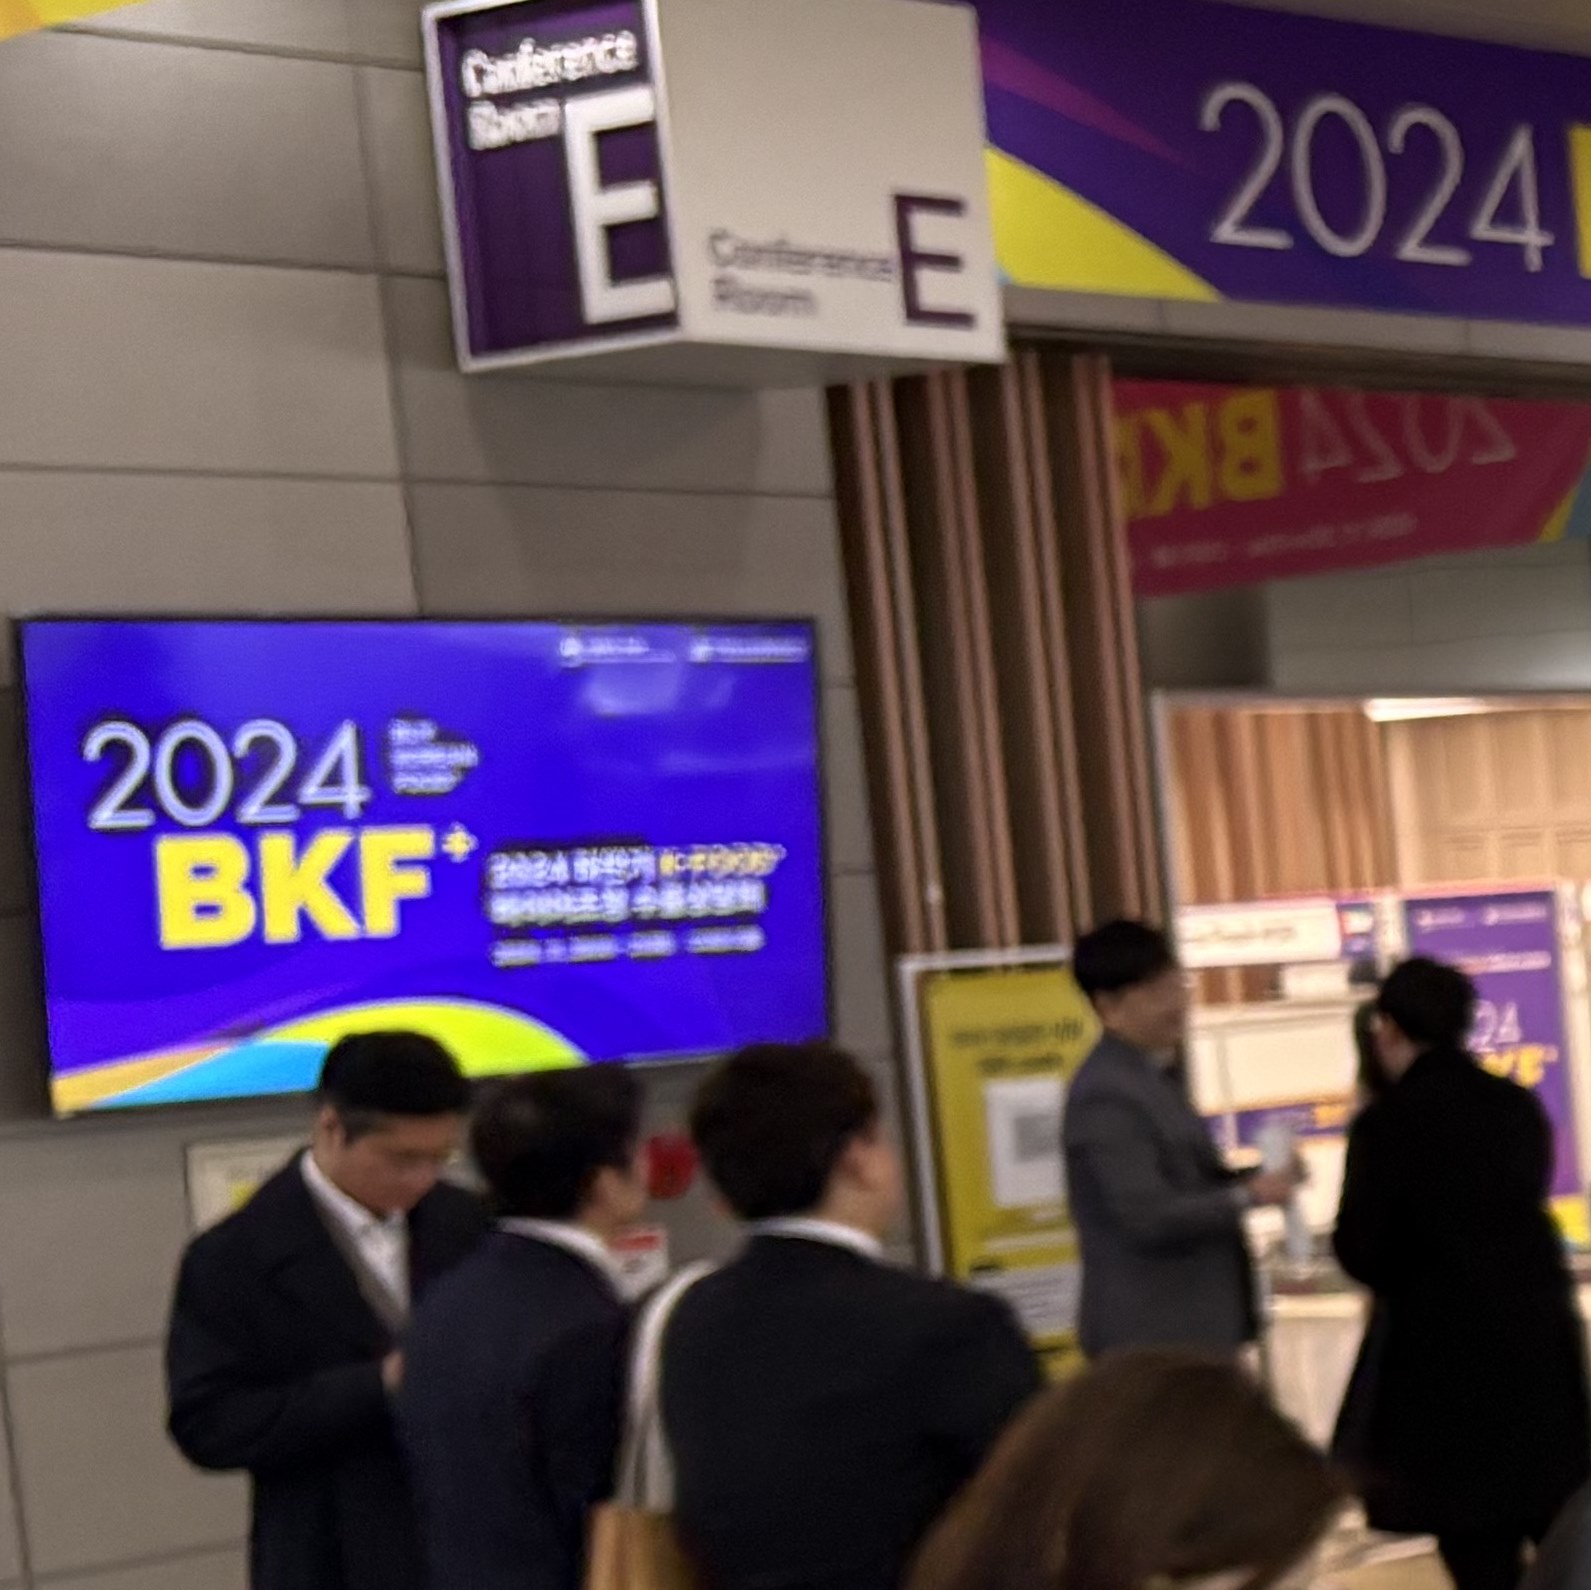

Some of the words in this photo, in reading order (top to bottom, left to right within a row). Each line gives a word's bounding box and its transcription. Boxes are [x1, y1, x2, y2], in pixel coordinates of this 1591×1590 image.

[461, 30, 638, 98] Conference
[563, 85, 678, 325] E
[1202, 81, 1556, 274] 2024
[893, 193, 979, 330] E
[82, 717, 372, 831] 2024
